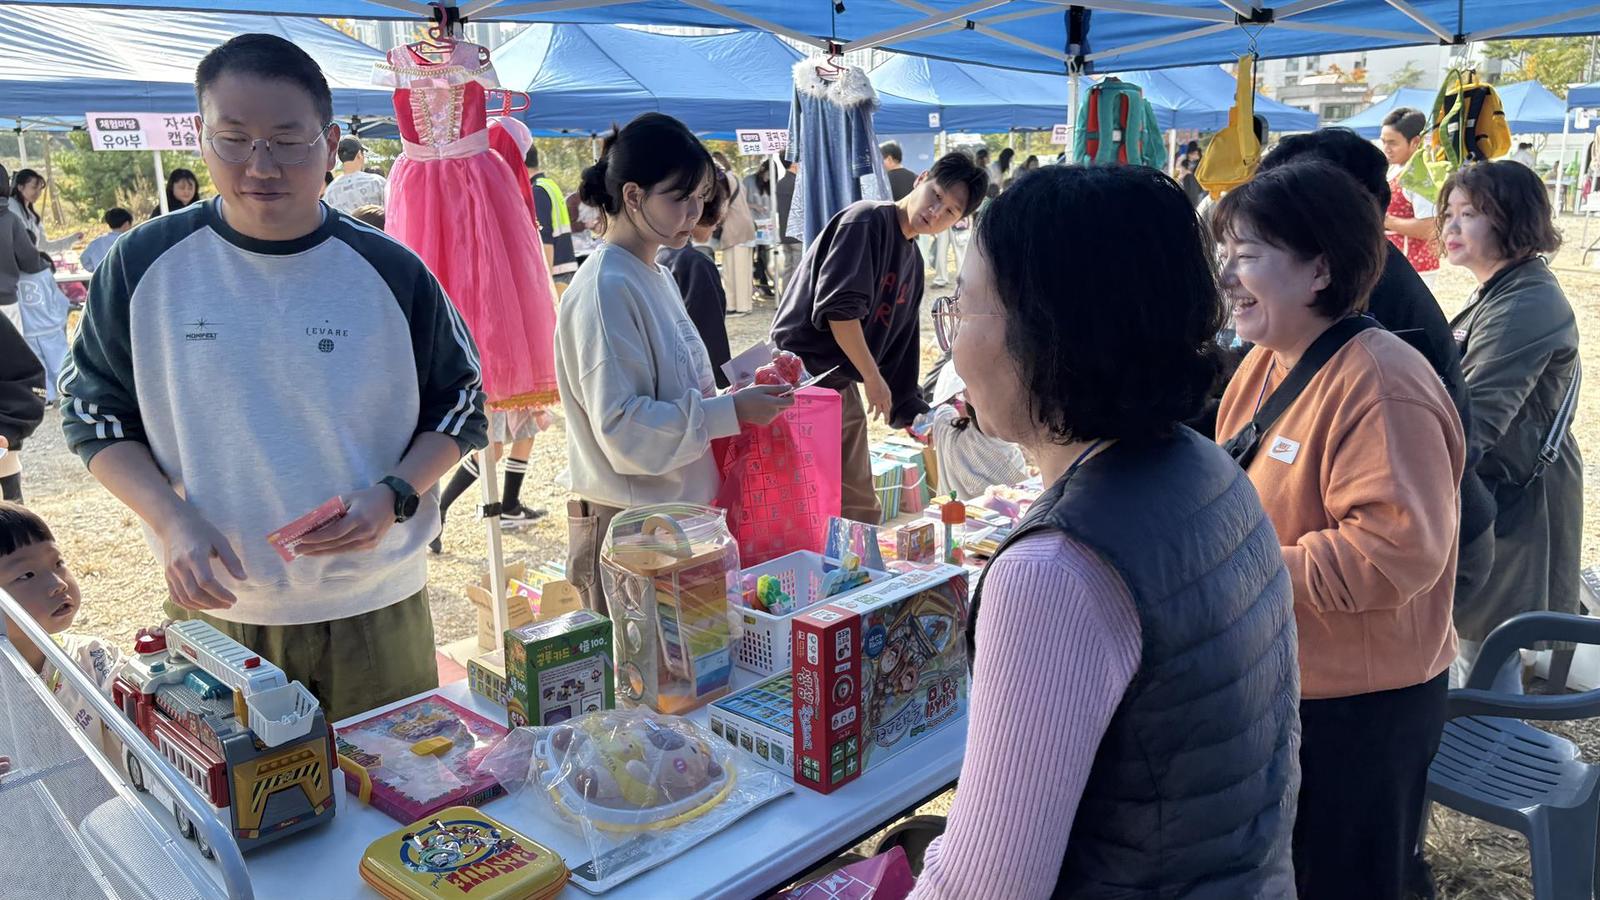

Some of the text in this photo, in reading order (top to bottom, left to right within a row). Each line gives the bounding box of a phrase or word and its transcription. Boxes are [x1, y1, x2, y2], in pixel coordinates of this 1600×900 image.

[163, 116, 194, 130] 자석
[103, 134, 141, 149] 유아부
[168, 131, 197, 147] 캡슐
[445, 843, 539, 893] RESCUE
